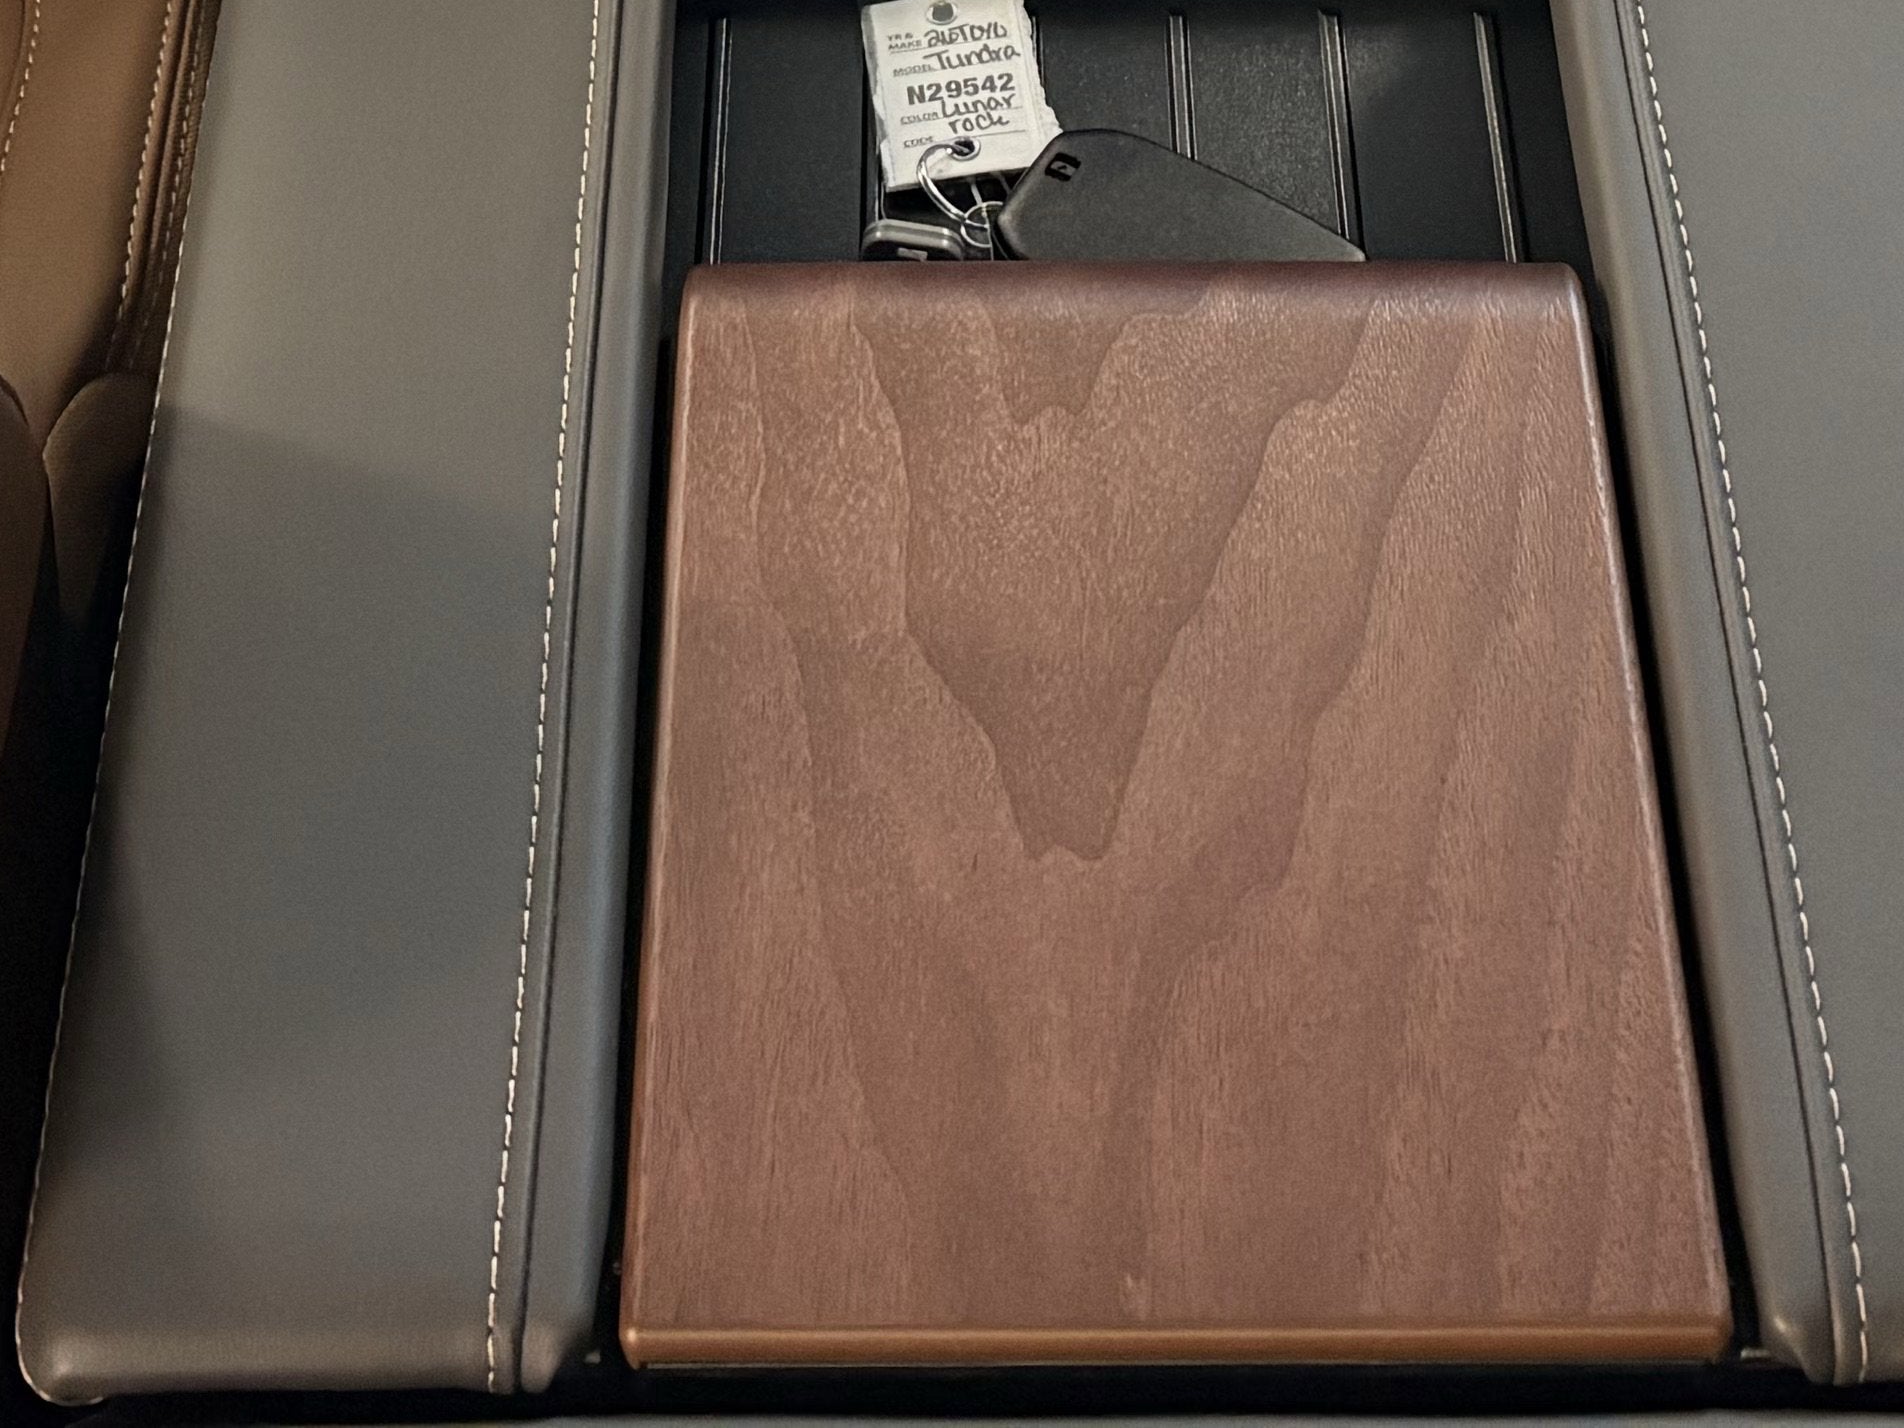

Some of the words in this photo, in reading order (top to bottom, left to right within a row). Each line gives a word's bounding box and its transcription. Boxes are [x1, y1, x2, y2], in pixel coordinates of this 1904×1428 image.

[888, 39, 923, 50] MAKE
[922, 42, 1021, 71] Tundra
[893, 63, 932, 77] MODEL
[906, 72, 1016, 106] N29542
[941, 92, 1016, 119] Lunar
[900, 111, 939, 125] COLOR
[903, 135, 935, 149] CODE
